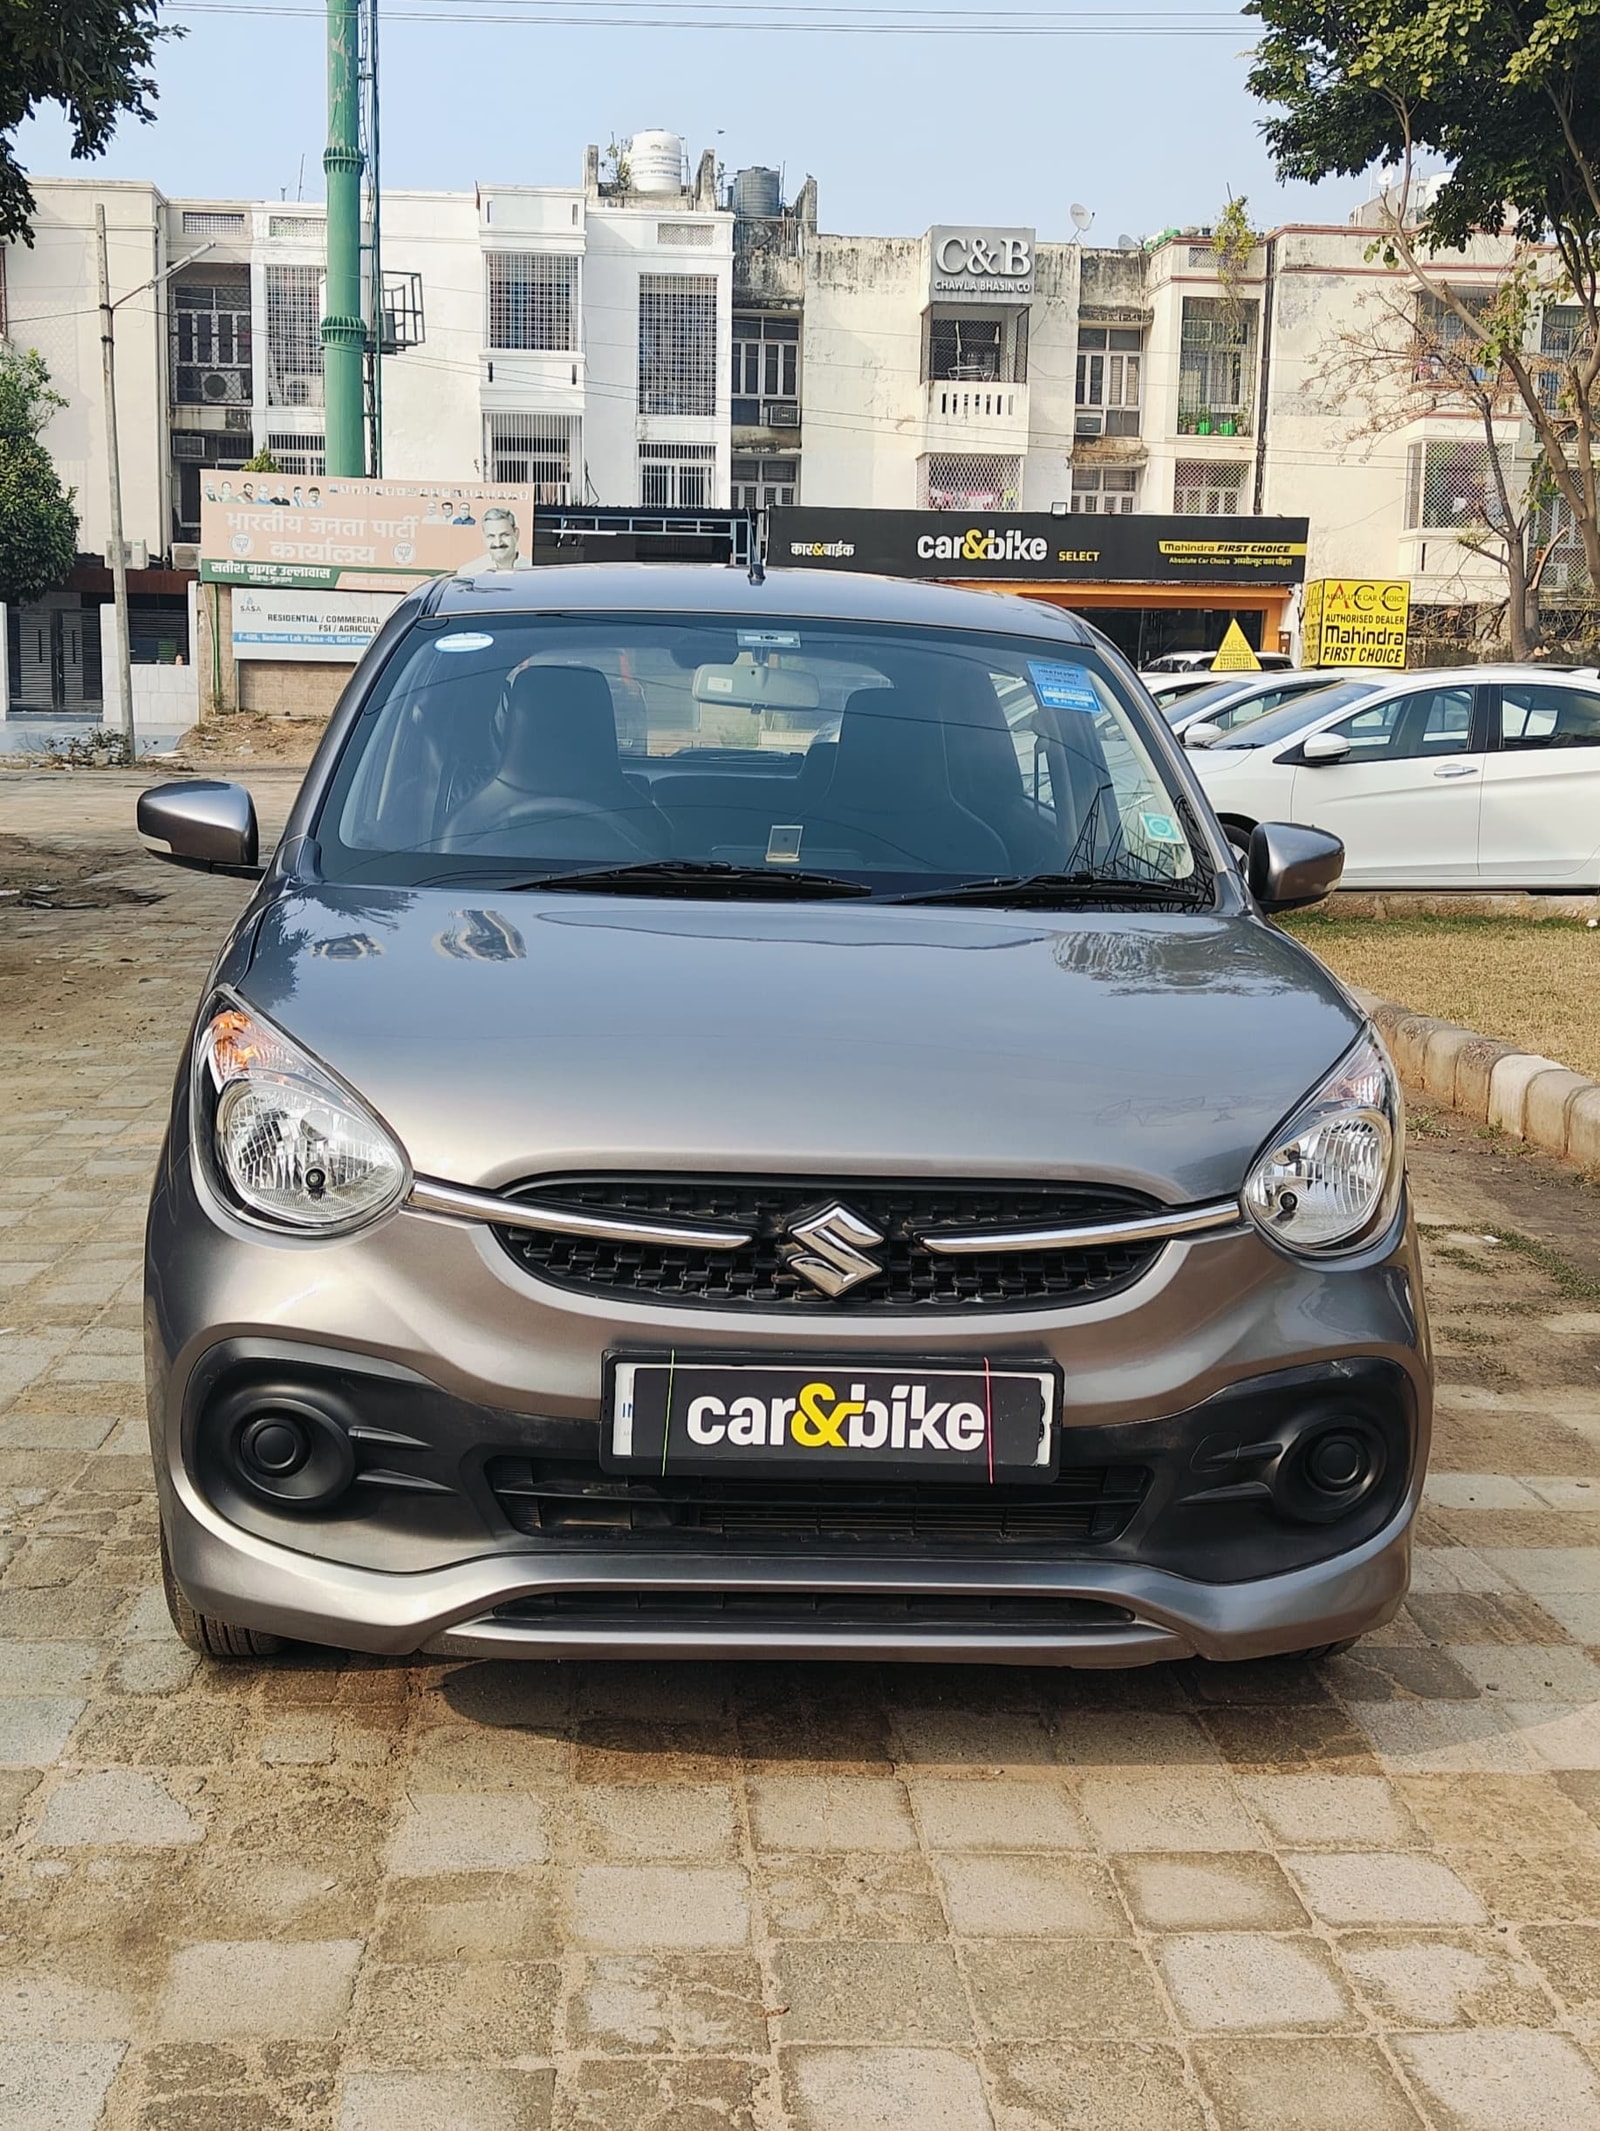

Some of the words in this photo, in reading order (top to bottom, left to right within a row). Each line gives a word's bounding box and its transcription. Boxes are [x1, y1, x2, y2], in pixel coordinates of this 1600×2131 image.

[936, 237, 1032, 276] C&B
[935, 280, 977, 291] CHAWLA
[980, 280, 1015, 292] BHASIN
[1017, 282, 1031, 292] CO
[226, 508, 304, 533] भारतीय
[308, 517, 367, 537] जनता
[370, 515, 419, 539] पार्टी
[269, 537, 376, 563] कार्यालय
[917, 529, 1047, 561] car&bike
[1164, 543, 1215, 552] Mahindra
[1217, 545, 1250, 553] FIRST
[1250, 545, 1291, 553] CHOICE
[1058, 551, 1100, 561] SELECT
[210, 560, 245, 574] सतीश
[1327, 583, 1403, 611] ACC
[268, 613, 319, 623] RESIDENTIAL
[326, 615, 381, 624] COMMERCIAL
[1325, 613, 1374, 623] AUTHORISED
[1376, 615, 1405, 624] DEALER
[1325, 625, 1404, 645] Mahindra
[1323, 646, 1356, 661] FIRST
[1359, 647, 1403, 663] CHOICE
[687, 1382, 985, 1452] car&bike
